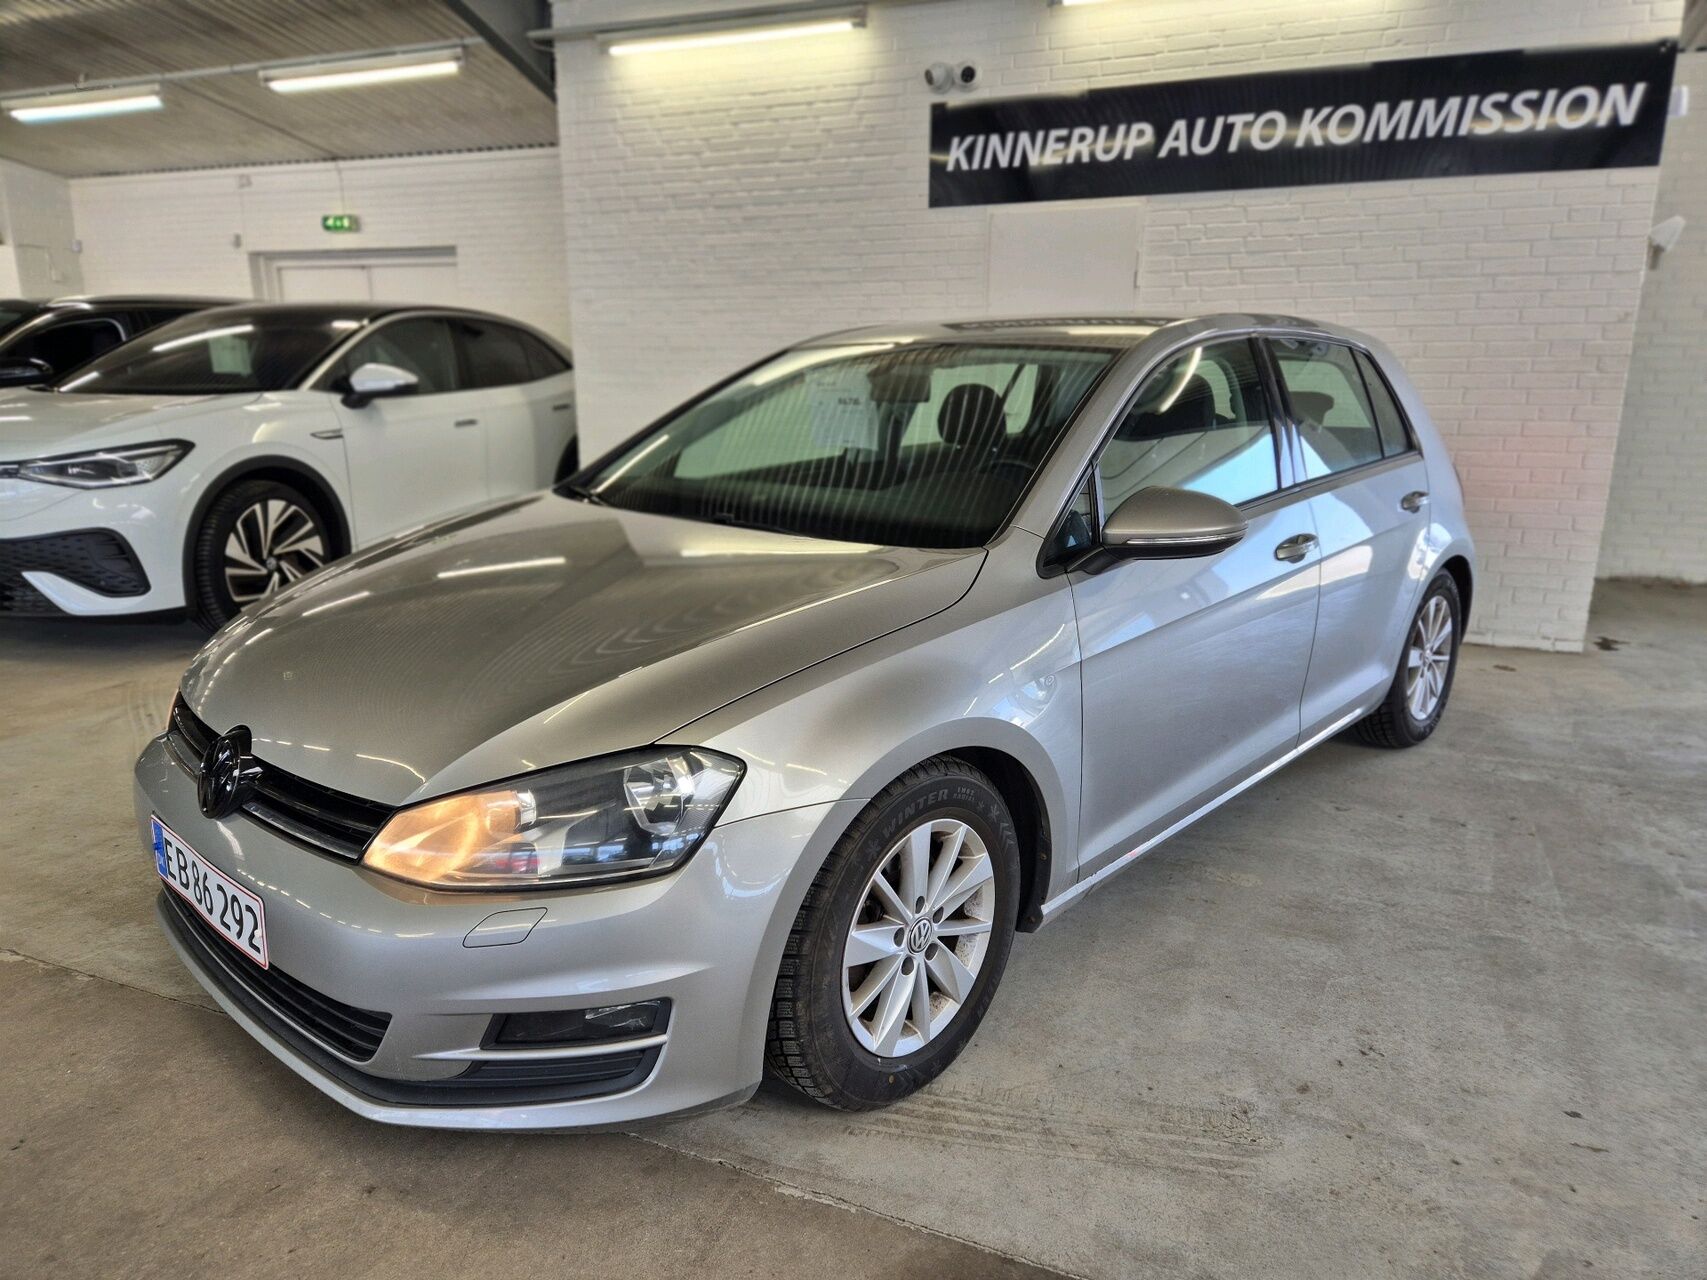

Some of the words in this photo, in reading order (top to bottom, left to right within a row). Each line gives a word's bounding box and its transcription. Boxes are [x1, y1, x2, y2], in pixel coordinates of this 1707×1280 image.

[946, 121, 1154, 172] KINNERUP
[1157, 110, 1286, 159] AUTO
[1294, 82, 1647, 148] KOMMISSION
[882, 788, 949, 838] WINTER
[164, 836, 190, 891] EB
[191, 860, 214, 916] 86
[216, 883, 261, 954] 292
